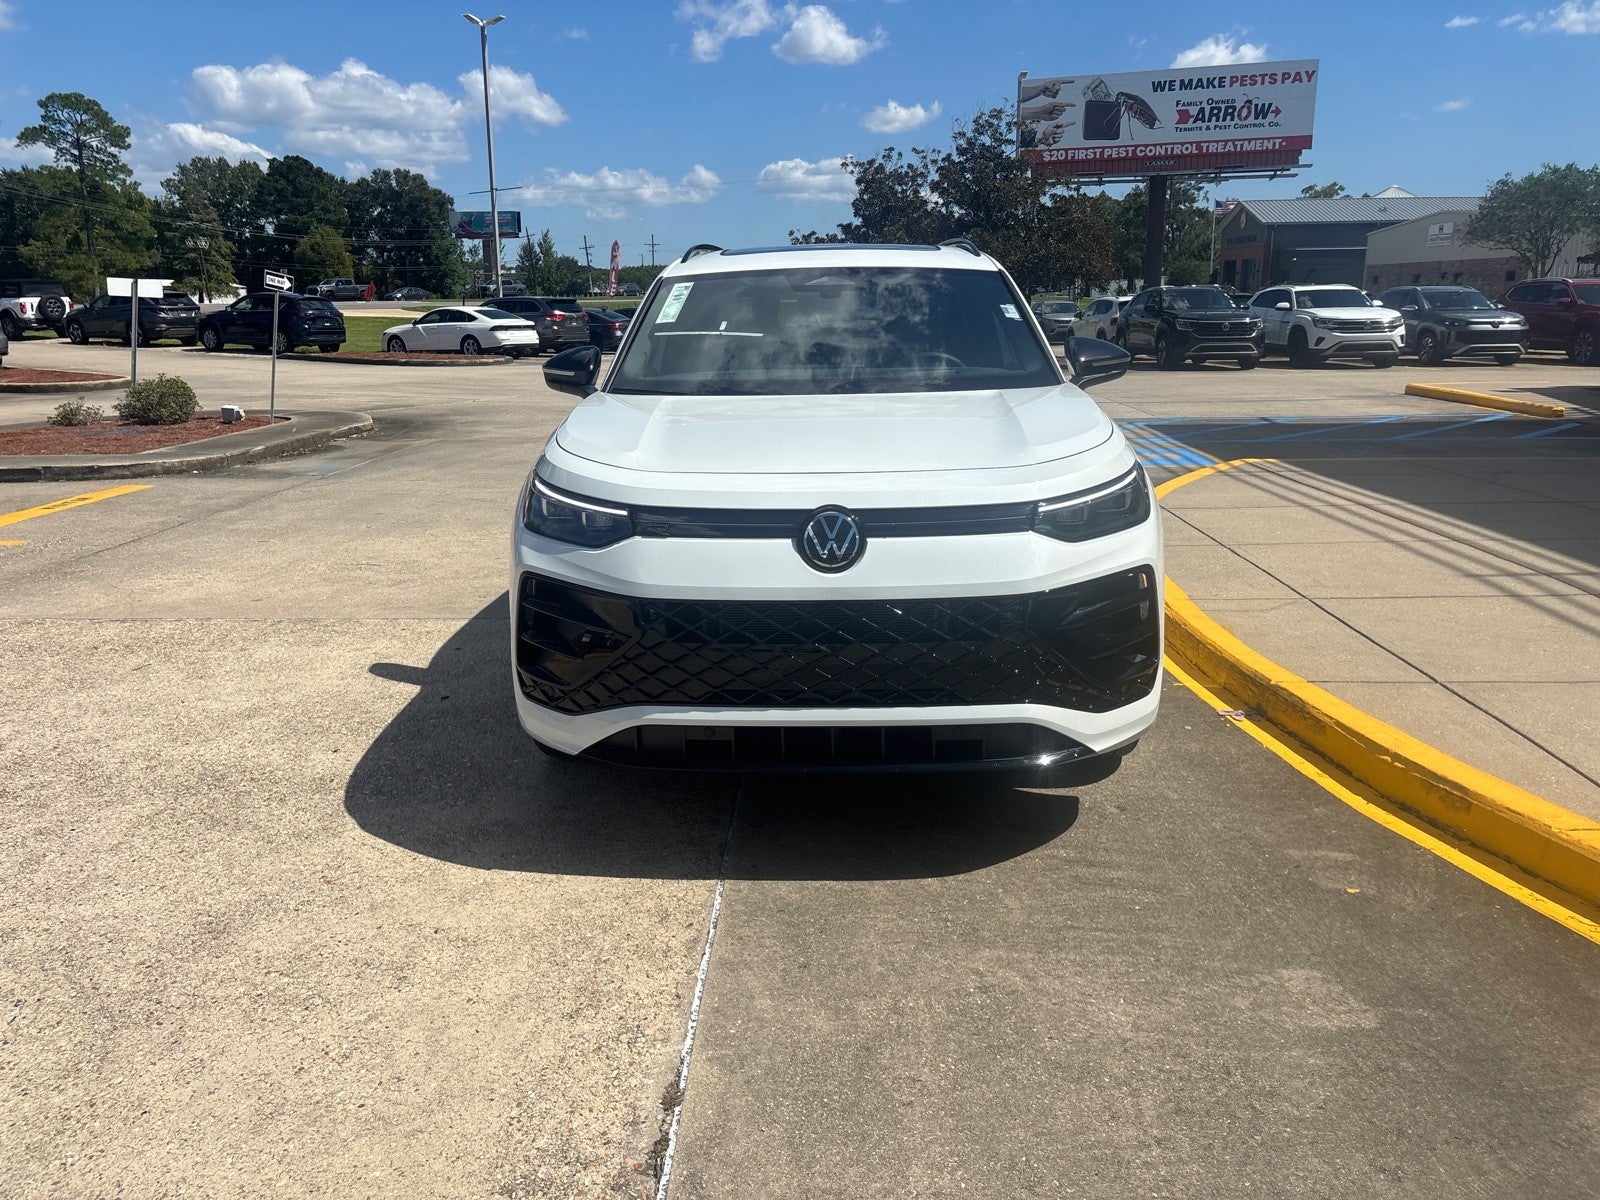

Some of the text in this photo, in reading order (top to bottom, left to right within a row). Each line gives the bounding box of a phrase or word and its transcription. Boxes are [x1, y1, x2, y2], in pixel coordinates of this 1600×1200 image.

[1151, 70, 1317, 93] WE MAKE PESTS PAY
[1192, 101, 1273, 124] ARROW
[1042, 150, 1066, 162] $20
[1067, 148, 1102, 160] FIRST
[1103, 146, 1135, 158] PEST
[1136, 143, 1199, 157] CONTROL
[267, 276, 286, 287] ONE WAY
[806, 513, 857, 564] VW
